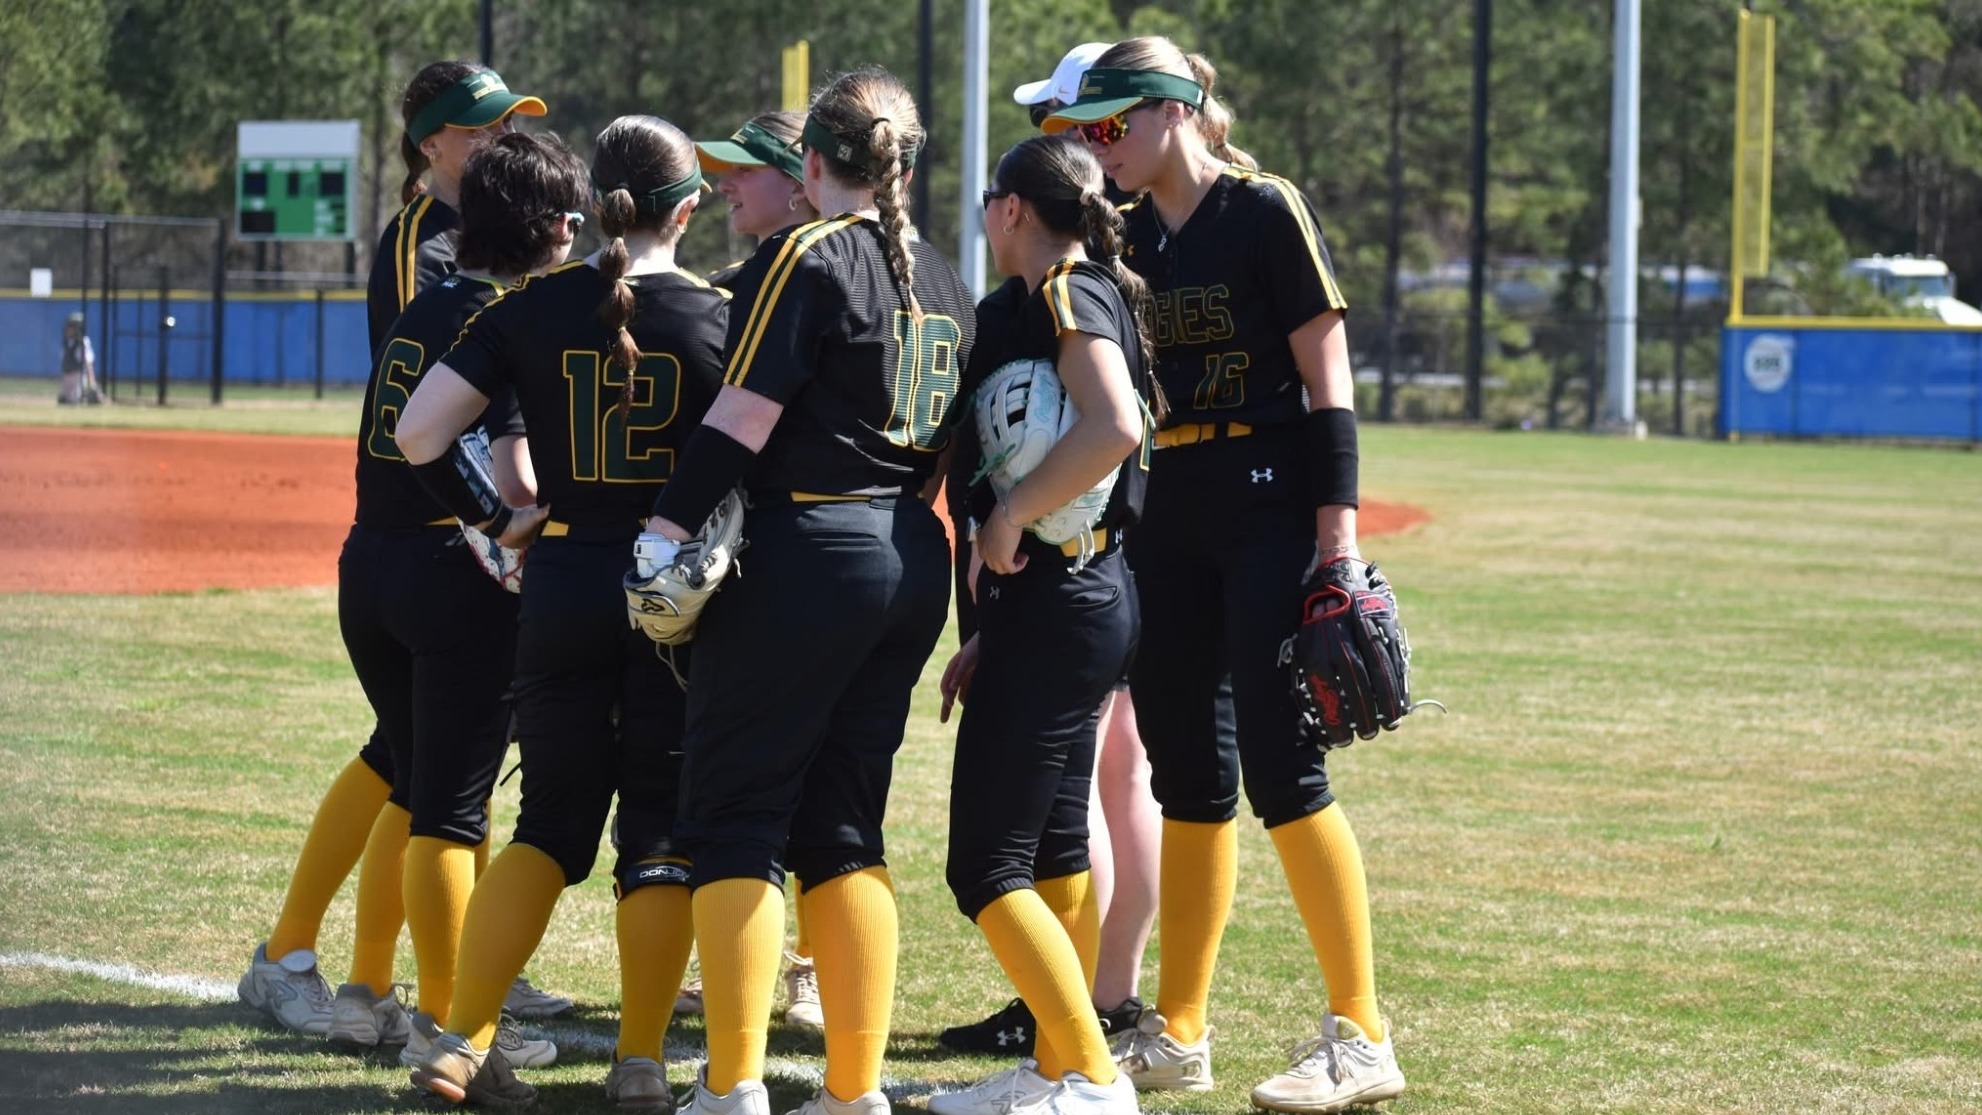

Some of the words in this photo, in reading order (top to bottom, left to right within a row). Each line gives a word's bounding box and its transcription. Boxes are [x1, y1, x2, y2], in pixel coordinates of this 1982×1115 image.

[1143, 284, 1235, 348] GIES
[368, 337, 425, 462] 6
[562, 349, 682, 483] 12
[884, 310, 961, 452] 18
[1193, 351, 1250, 411] 16
